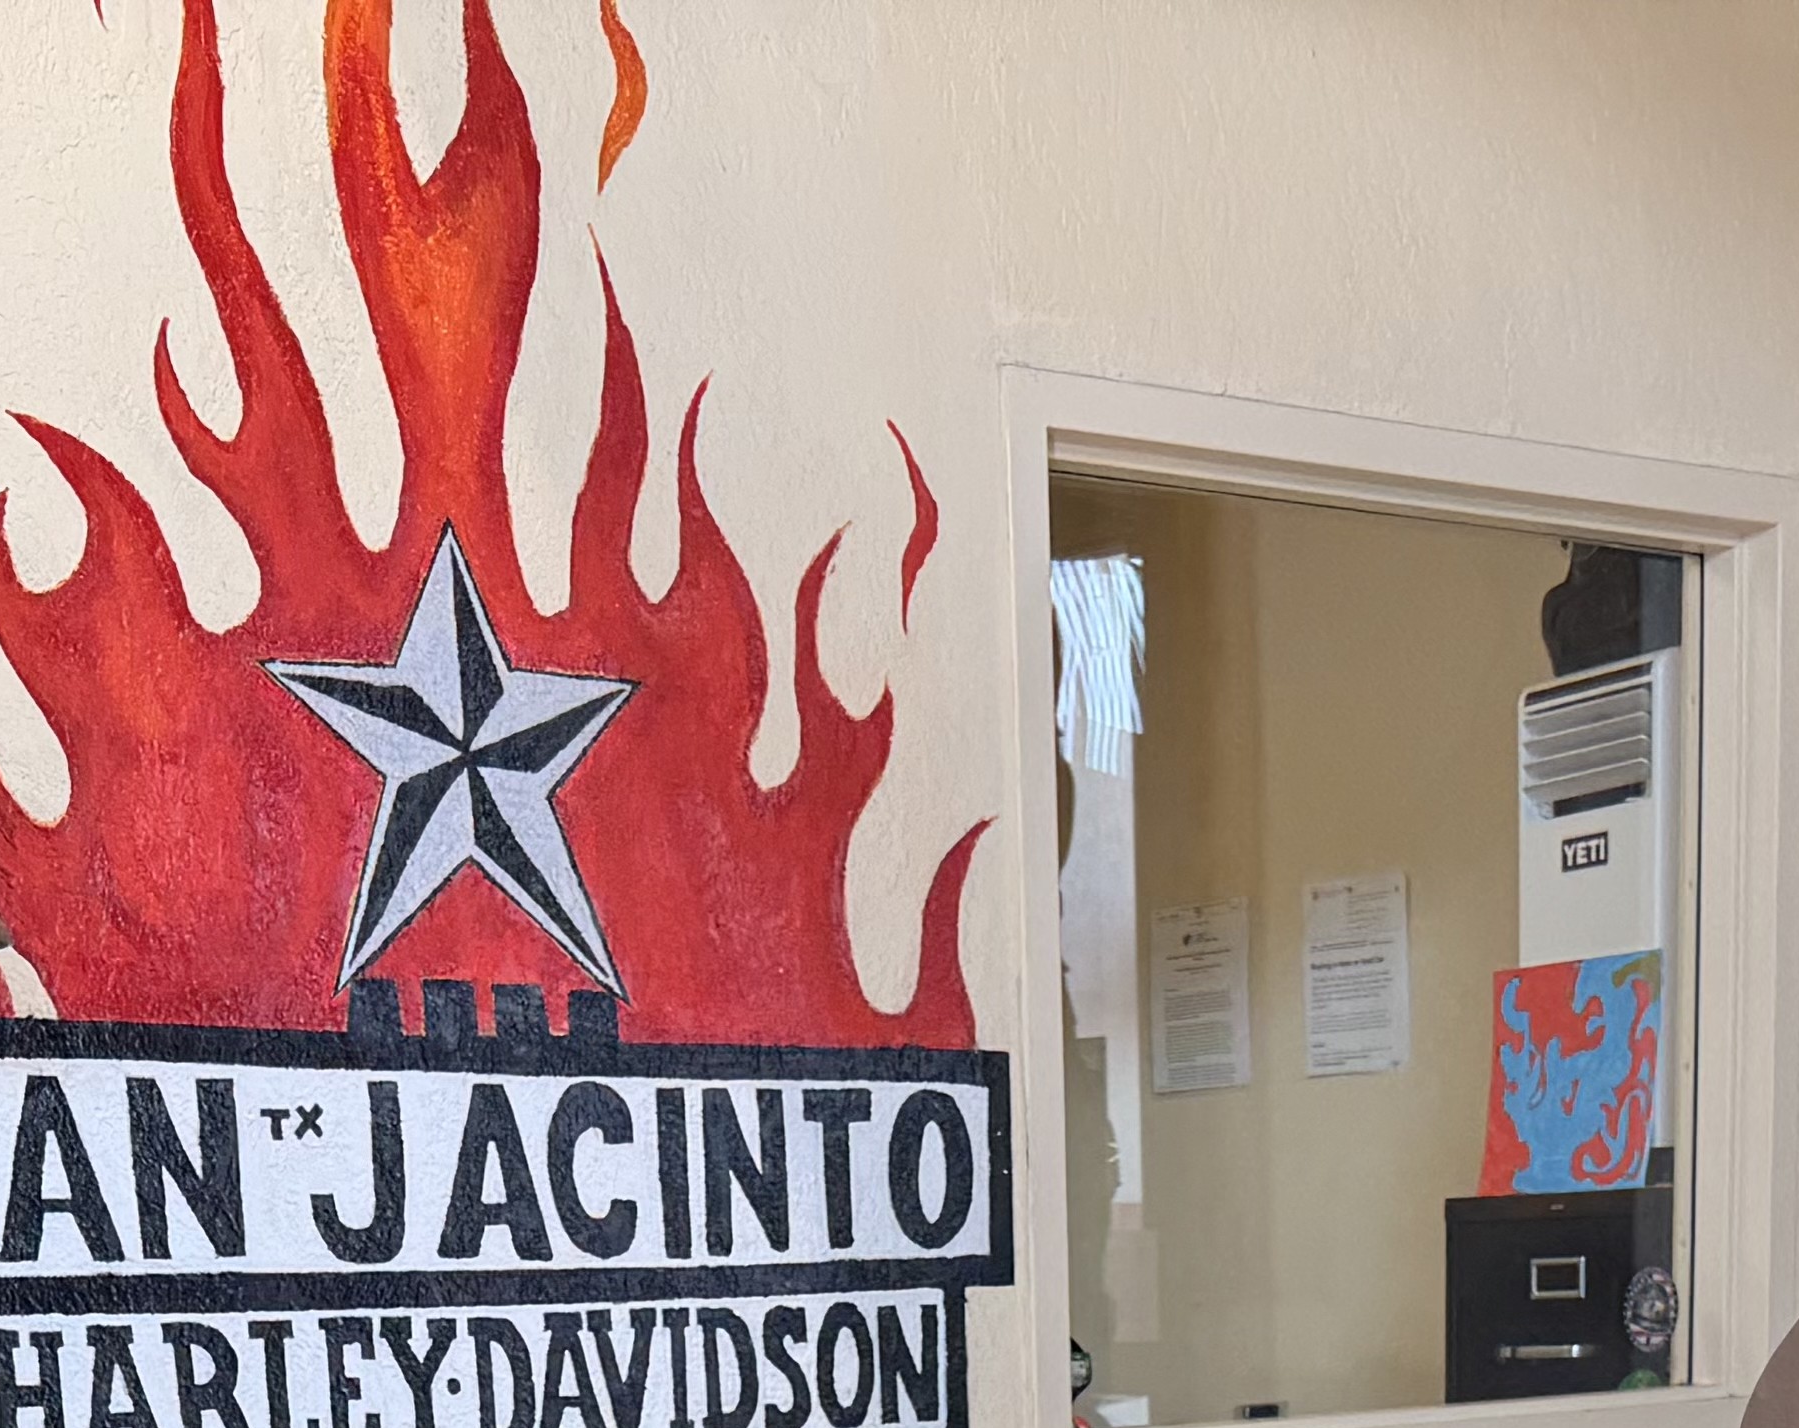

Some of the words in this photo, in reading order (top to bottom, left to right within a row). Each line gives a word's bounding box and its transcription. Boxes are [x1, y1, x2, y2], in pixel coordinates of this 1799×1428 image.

[1564, 836, 1605, 867] YETI
[260, 1104, 326, 1141] TX
[311, 1081, 975, 1265] JACINTO
